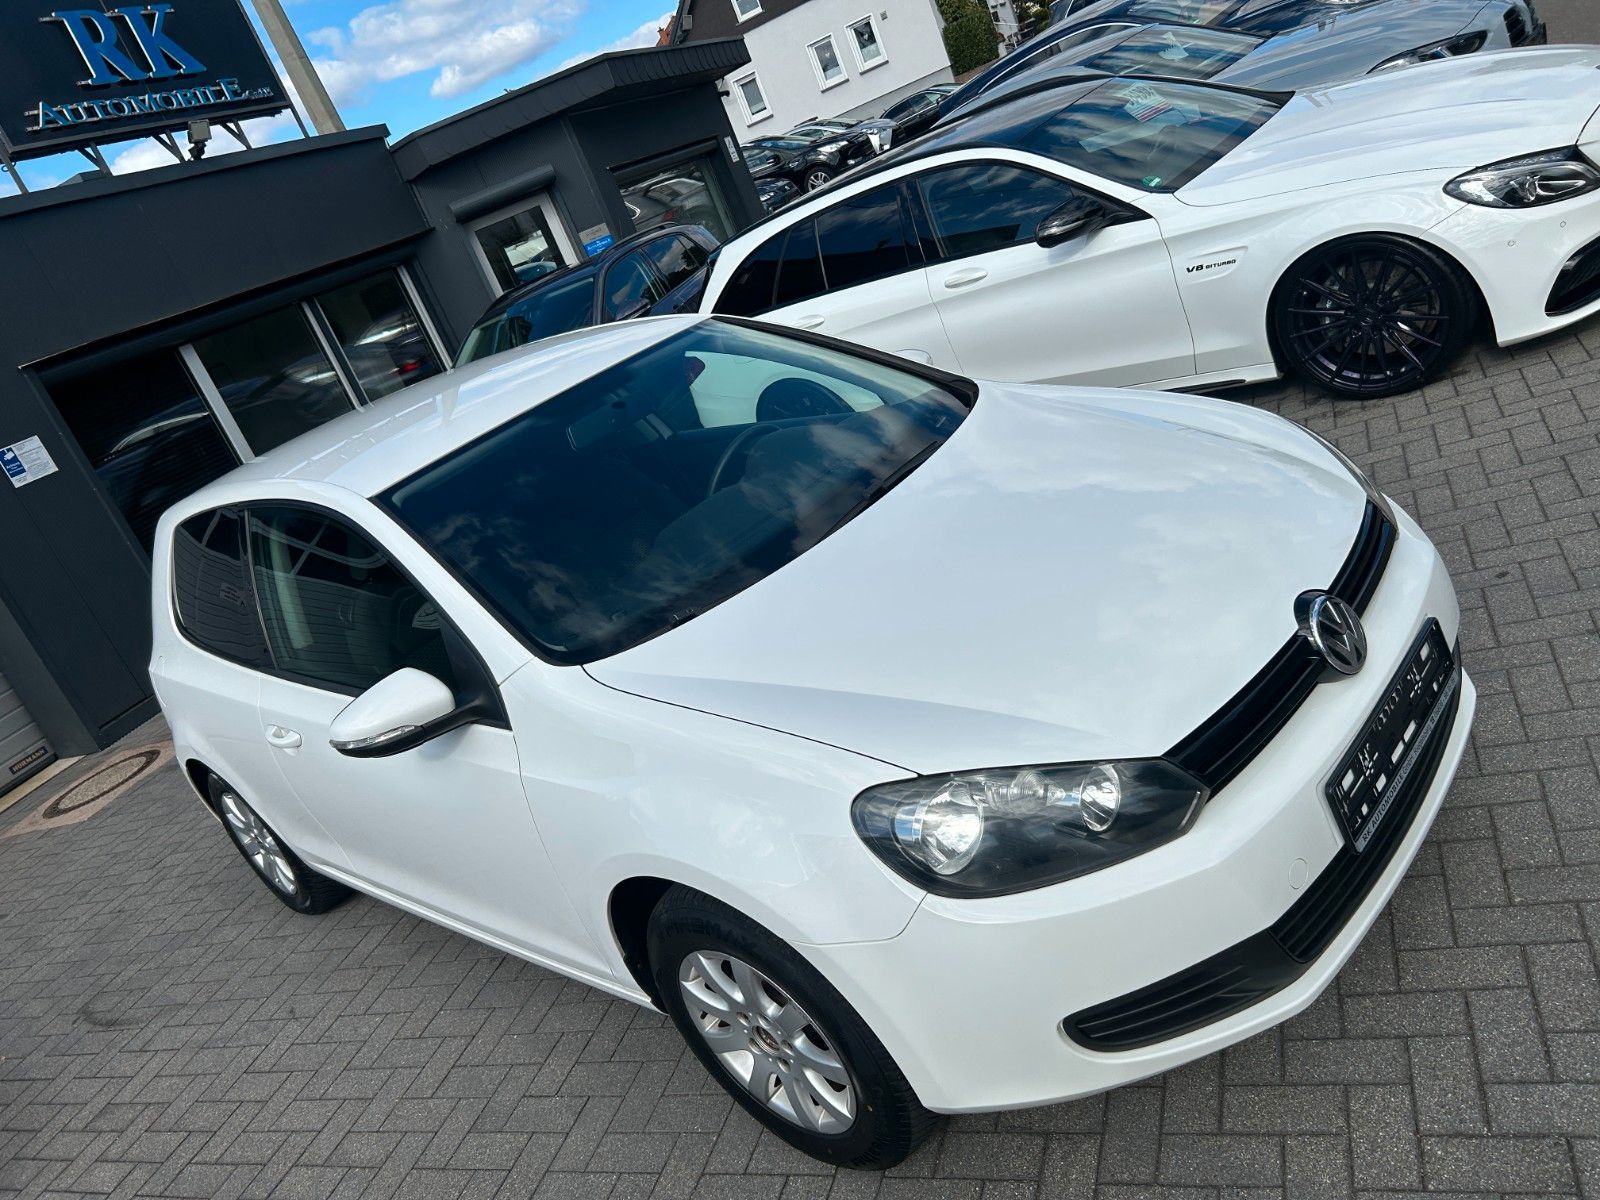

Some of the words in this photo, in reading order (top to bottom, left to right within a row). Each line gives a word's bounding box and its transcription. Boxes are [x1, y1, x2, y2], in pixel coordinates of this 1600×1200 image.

[39, 4, 207, 86] RK
[1186, 264, 1204, 273] V8
[1205, 259, 1237, 269] BITURBO
[1361, 828, 1373, 842] RK
[1370, 774, 1403, 828] AUTOMOBILE
